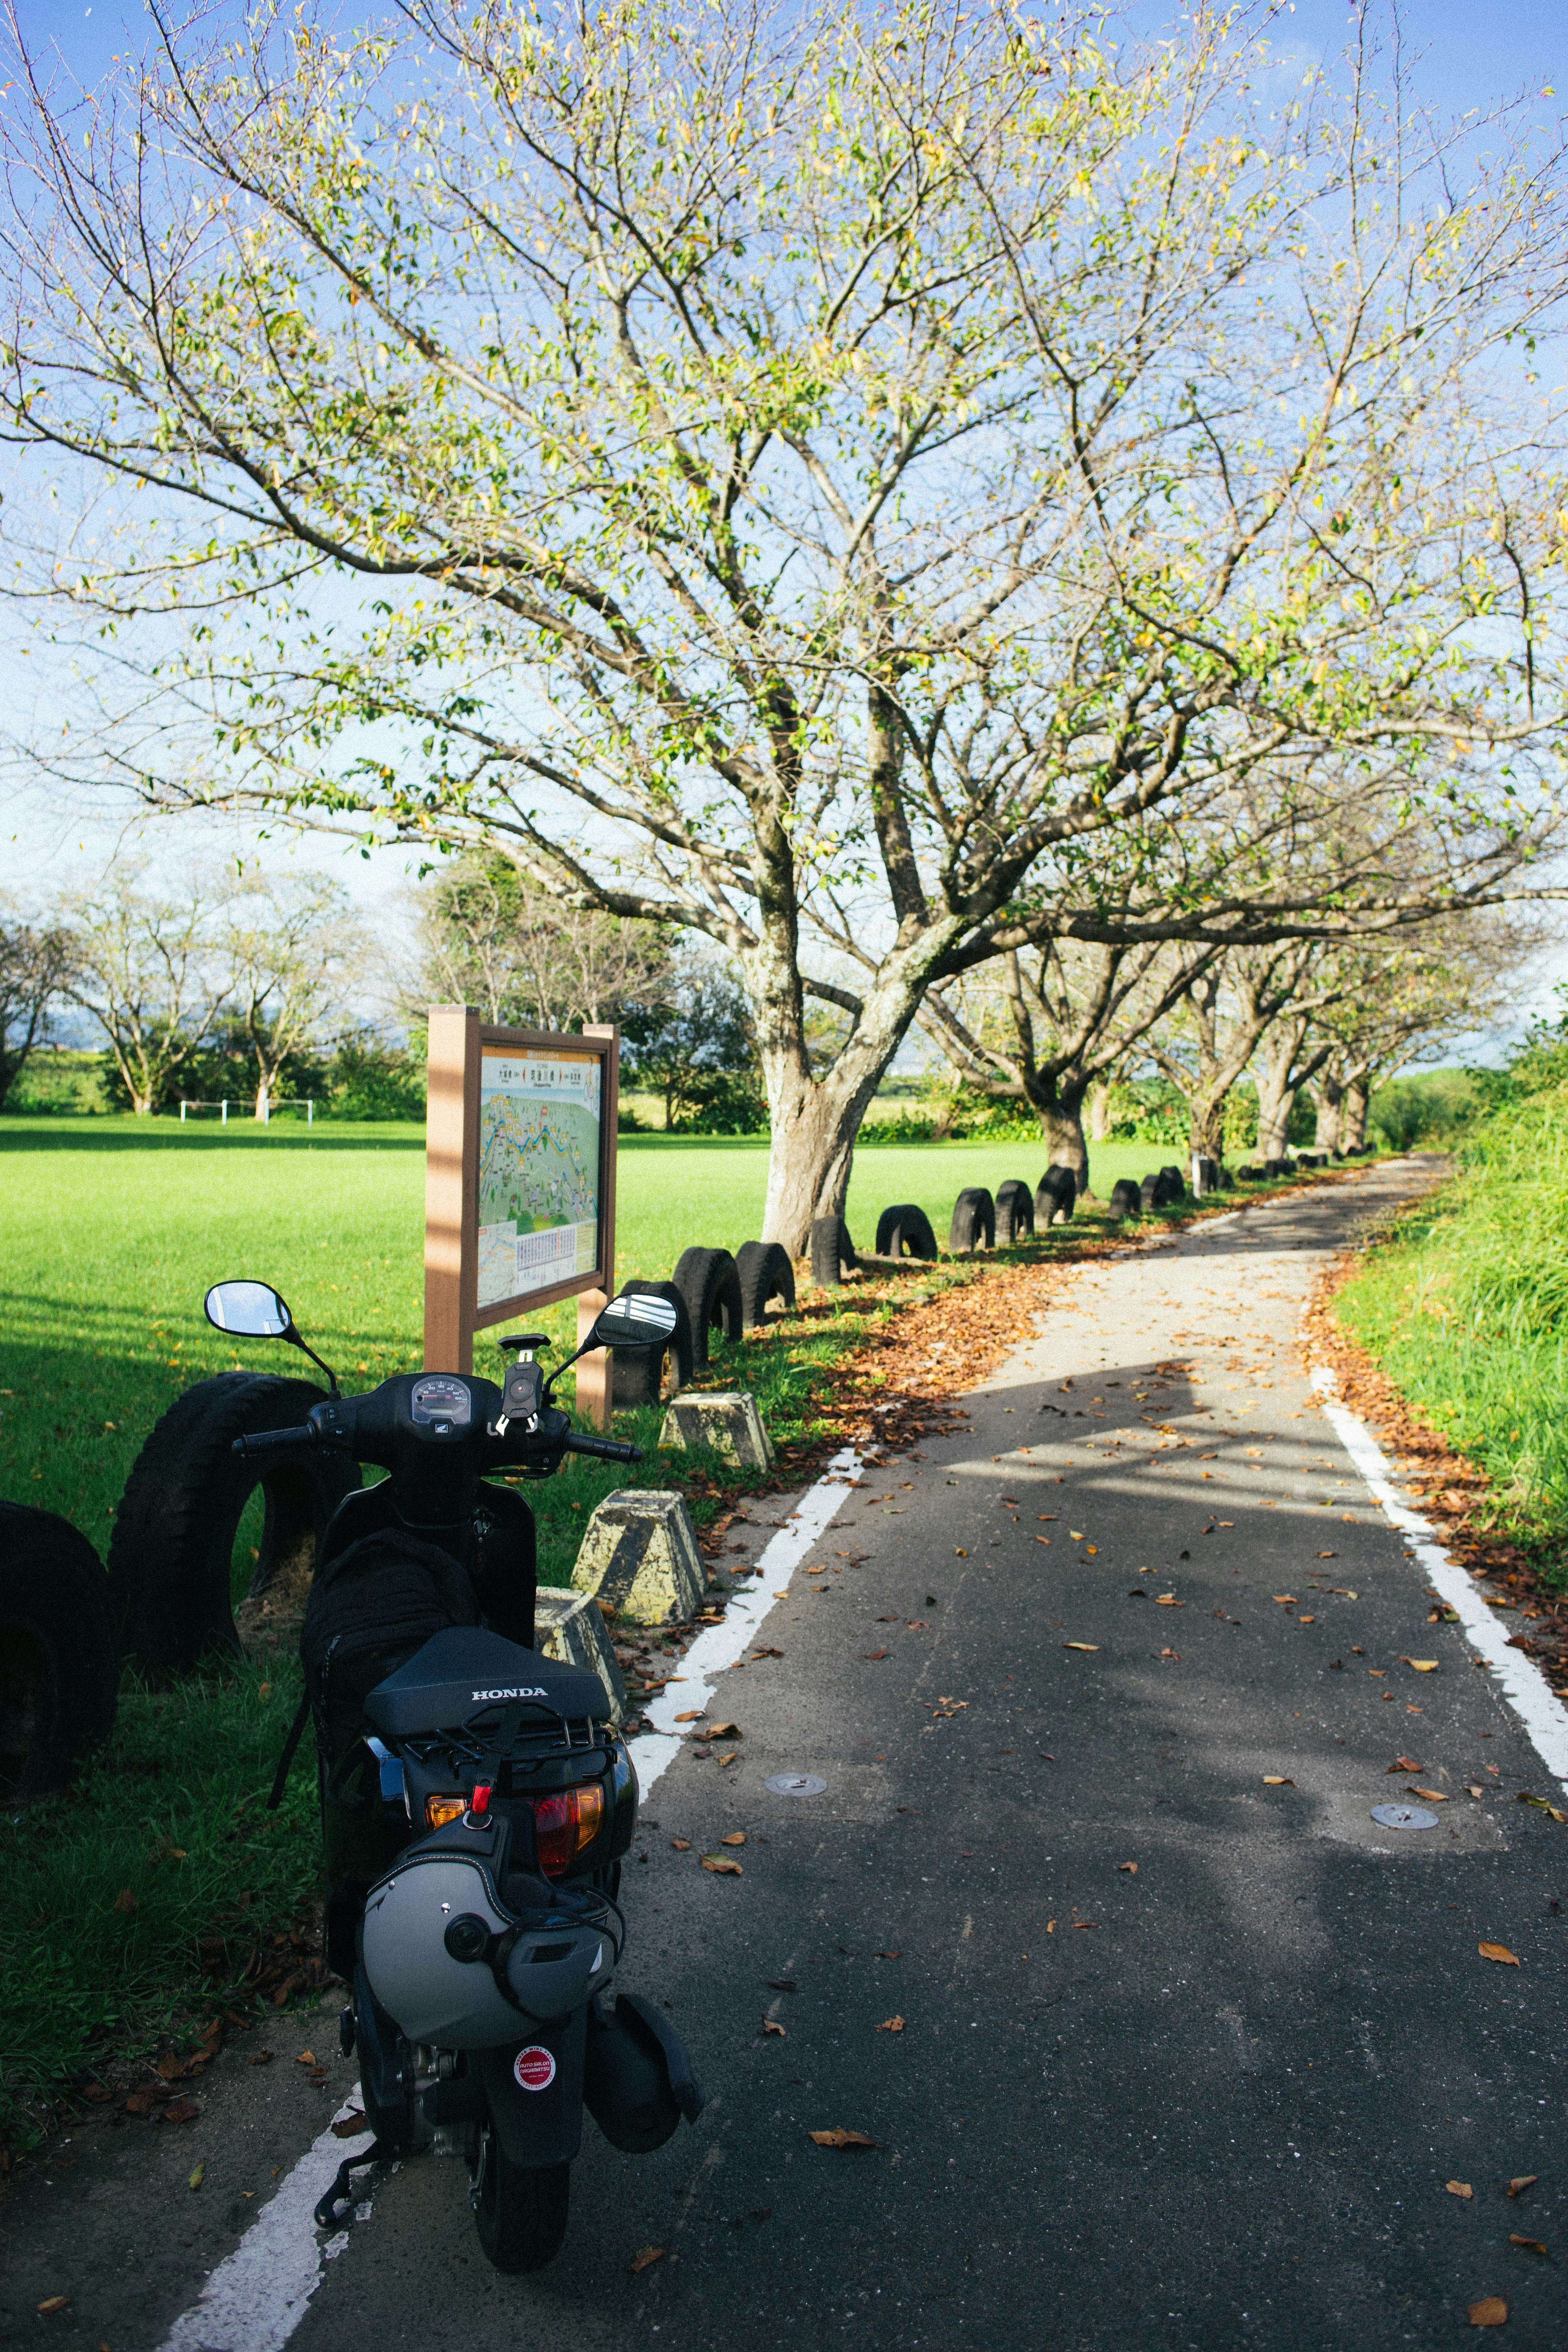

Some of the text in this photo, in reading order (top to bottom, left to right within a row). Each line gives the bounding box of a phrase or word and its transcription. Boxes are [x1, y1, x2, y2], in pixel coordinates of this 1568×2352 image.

[472, 1687, 548, 1700] HONDA
[516, 2050, 527, 2065] HONDA
[544, 2051, 554, 2062] PROS
